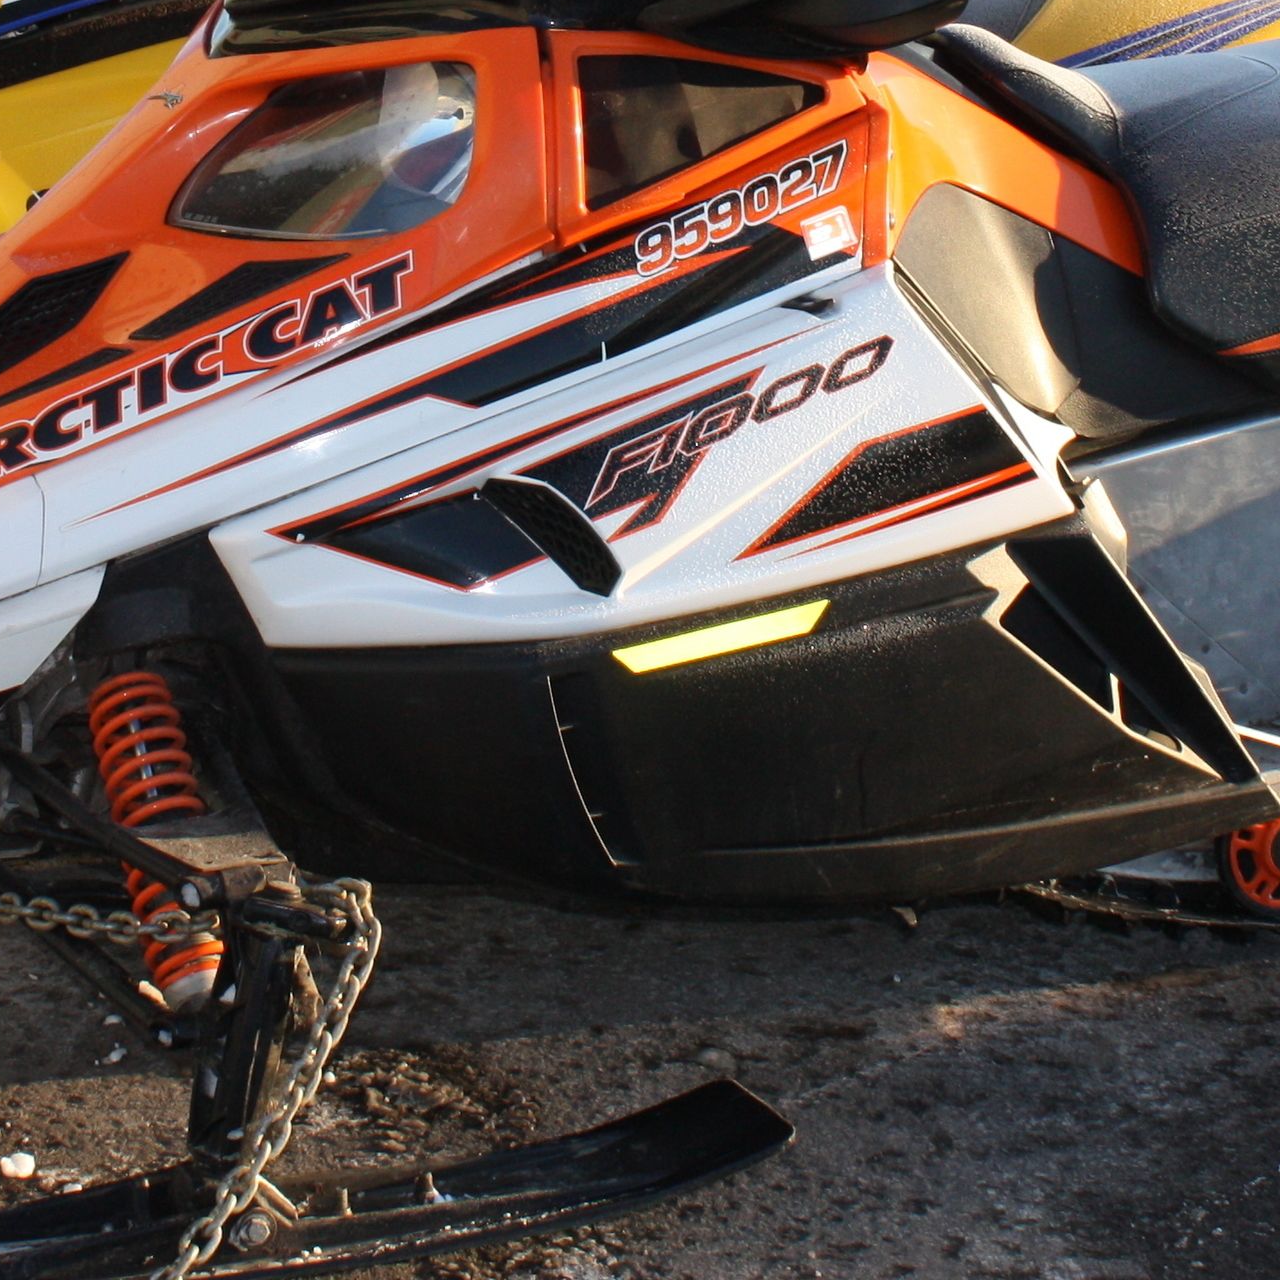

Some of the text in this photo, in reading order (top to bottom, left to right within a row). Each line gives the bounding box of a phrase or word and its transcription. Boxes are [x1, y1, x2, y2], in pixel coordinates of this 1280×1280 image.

[633, 138, 849, 278] 959027
[242, 249, 415, 363] CAT
[585, 334, 895, 511] F1000
